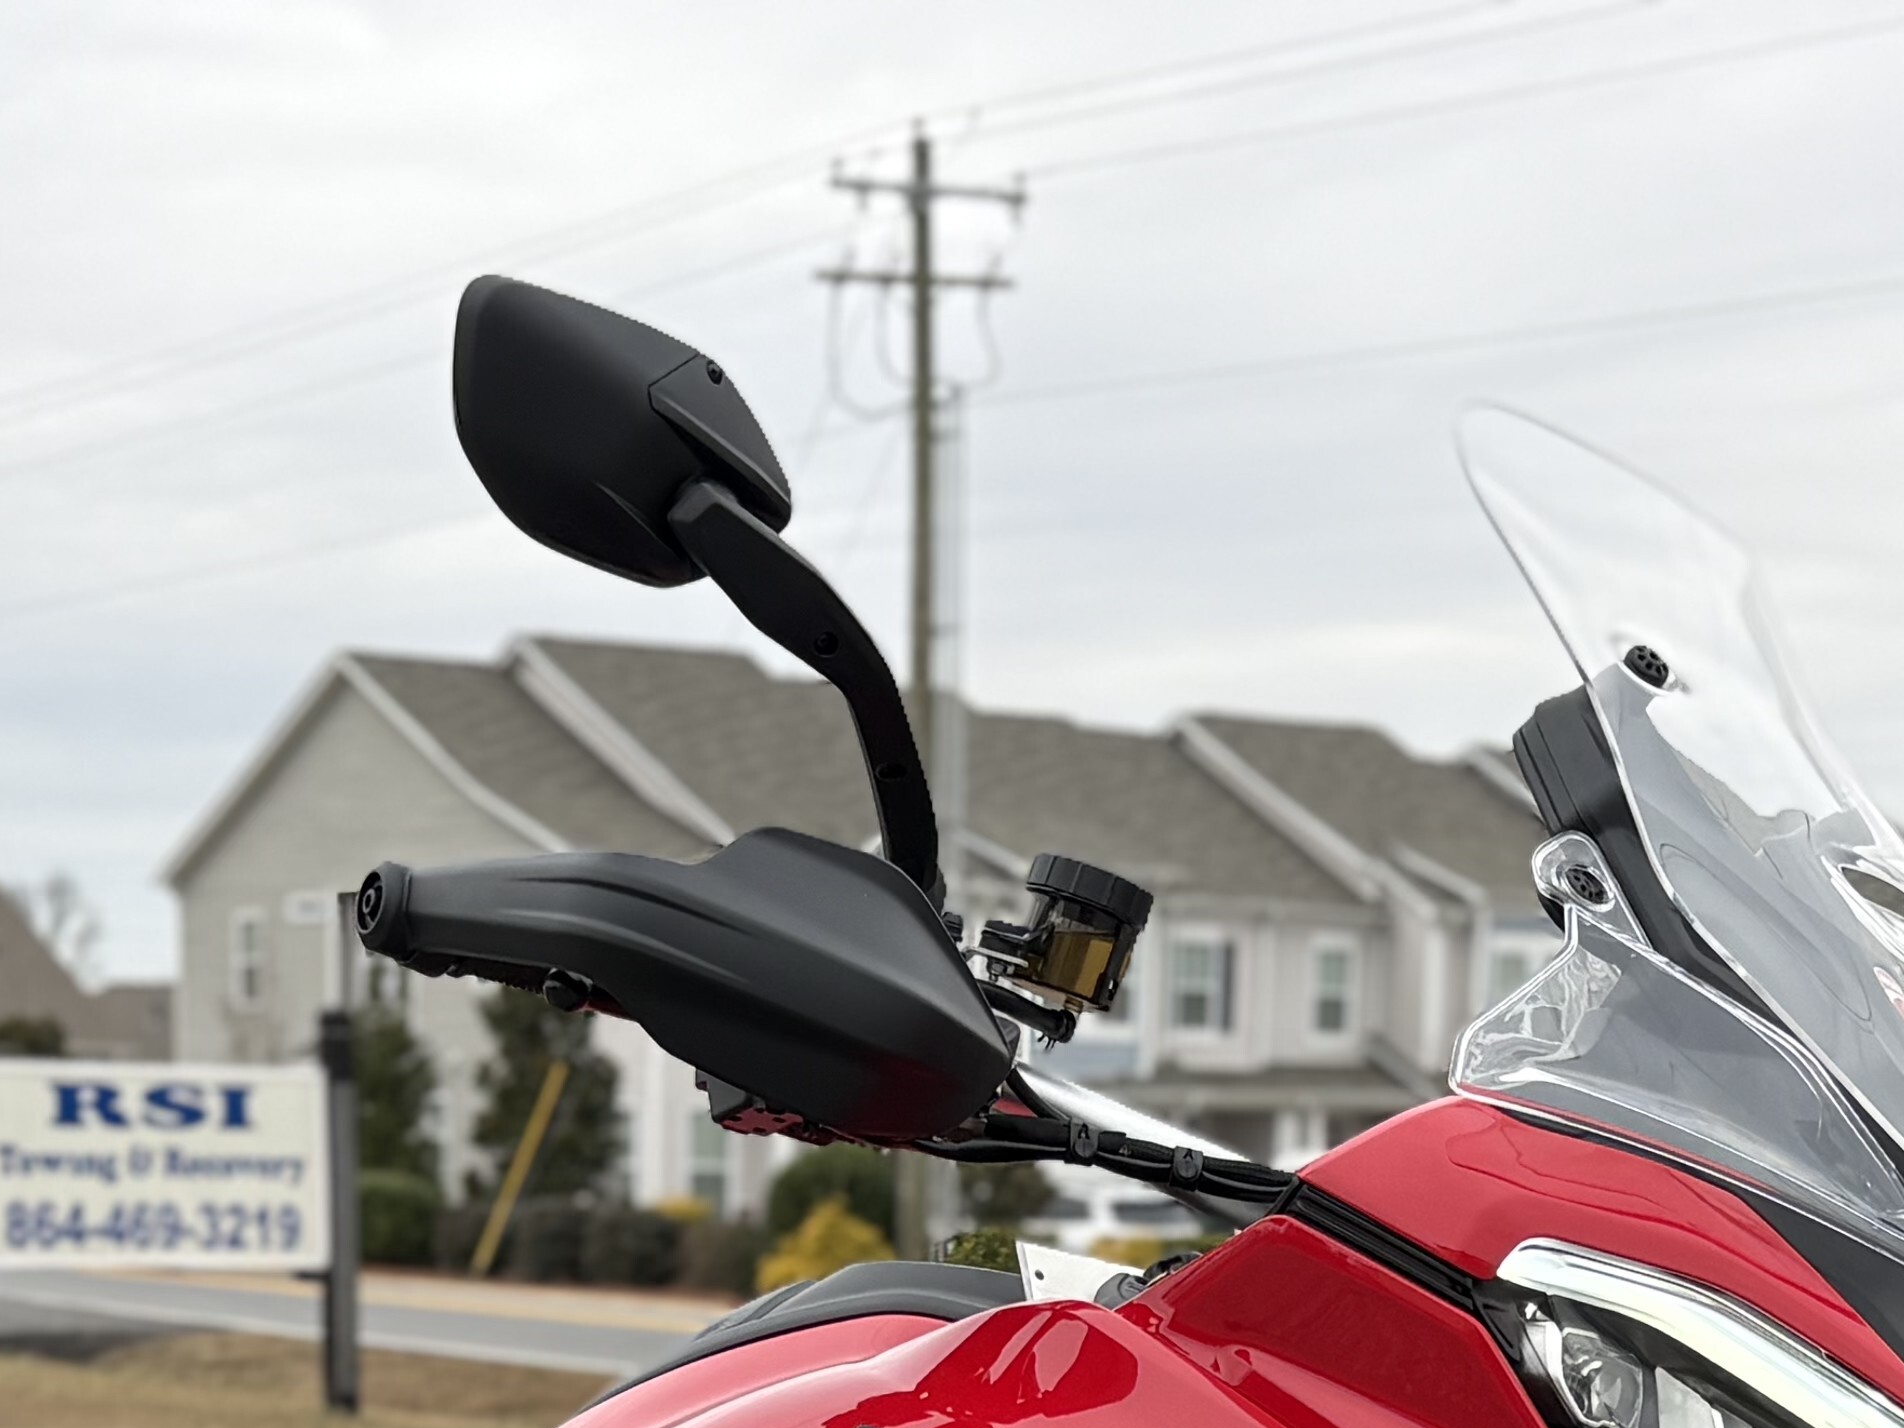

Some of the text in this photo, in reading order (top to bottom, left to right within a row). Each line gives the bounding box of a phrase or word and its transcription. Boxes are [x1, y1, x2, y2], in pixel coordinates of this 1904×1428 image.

[52, 1083, 254, 1128] RSI
[163, 1149, 304, 1186] Recovery
[4, 1201, 302, 1251] 864-469-3219
